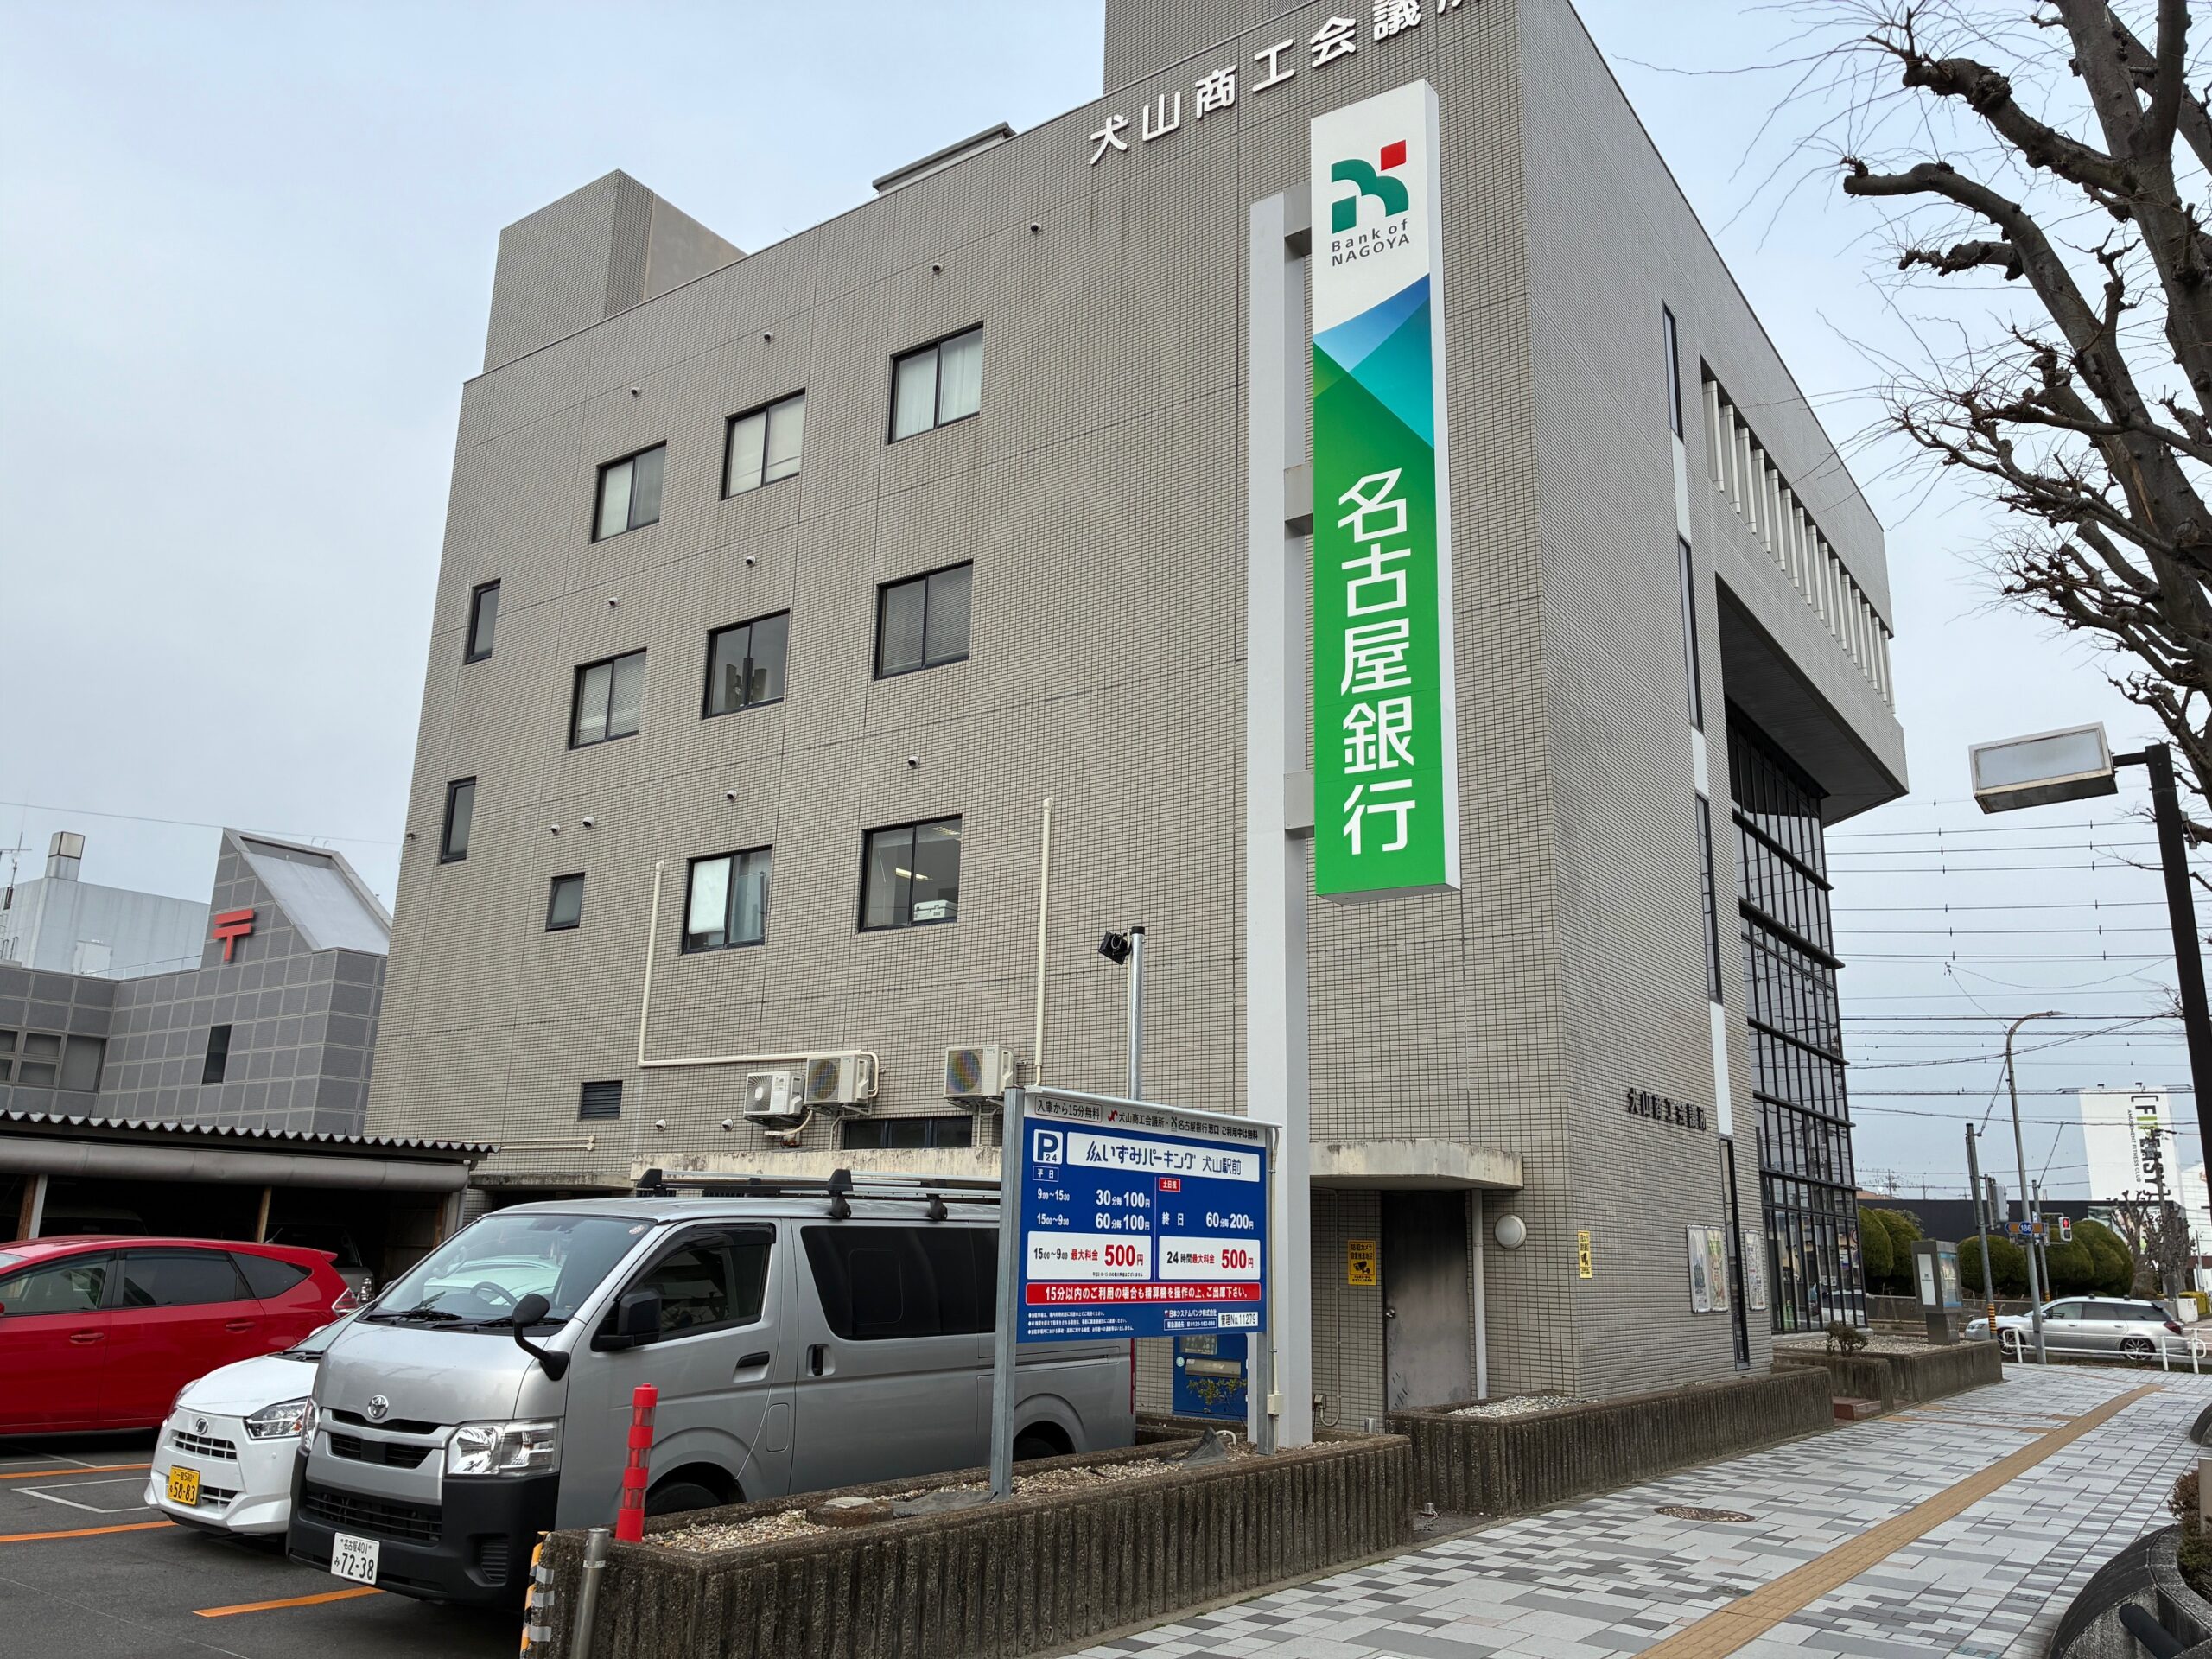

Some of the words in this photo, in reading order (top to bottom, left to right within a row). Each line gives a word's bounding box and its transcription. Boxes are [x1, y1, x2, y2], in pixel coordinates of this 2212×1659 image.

[1332, 226, 1381, 253] Bank
[1388, 218, 1409, 235] of
[1332, 233, 1410, 267] NAGOYA
[1338, 467, 1415, 855] 名古屋銀行
[1037, 1099, 1100, 1121] 入庫から15分無料
[1037, 1168, 1054, 1179] 平日
[1102, 1143, 1196, 1170] いずみパーキング
[1202, 1155, 1242, 1176] 犬山駅前
[1071, 1249, 1098, 1261] 最大料金
[1104, 1244, 1144, 1267] 500円
[1221, 1249, 1255, 1269] 500円
